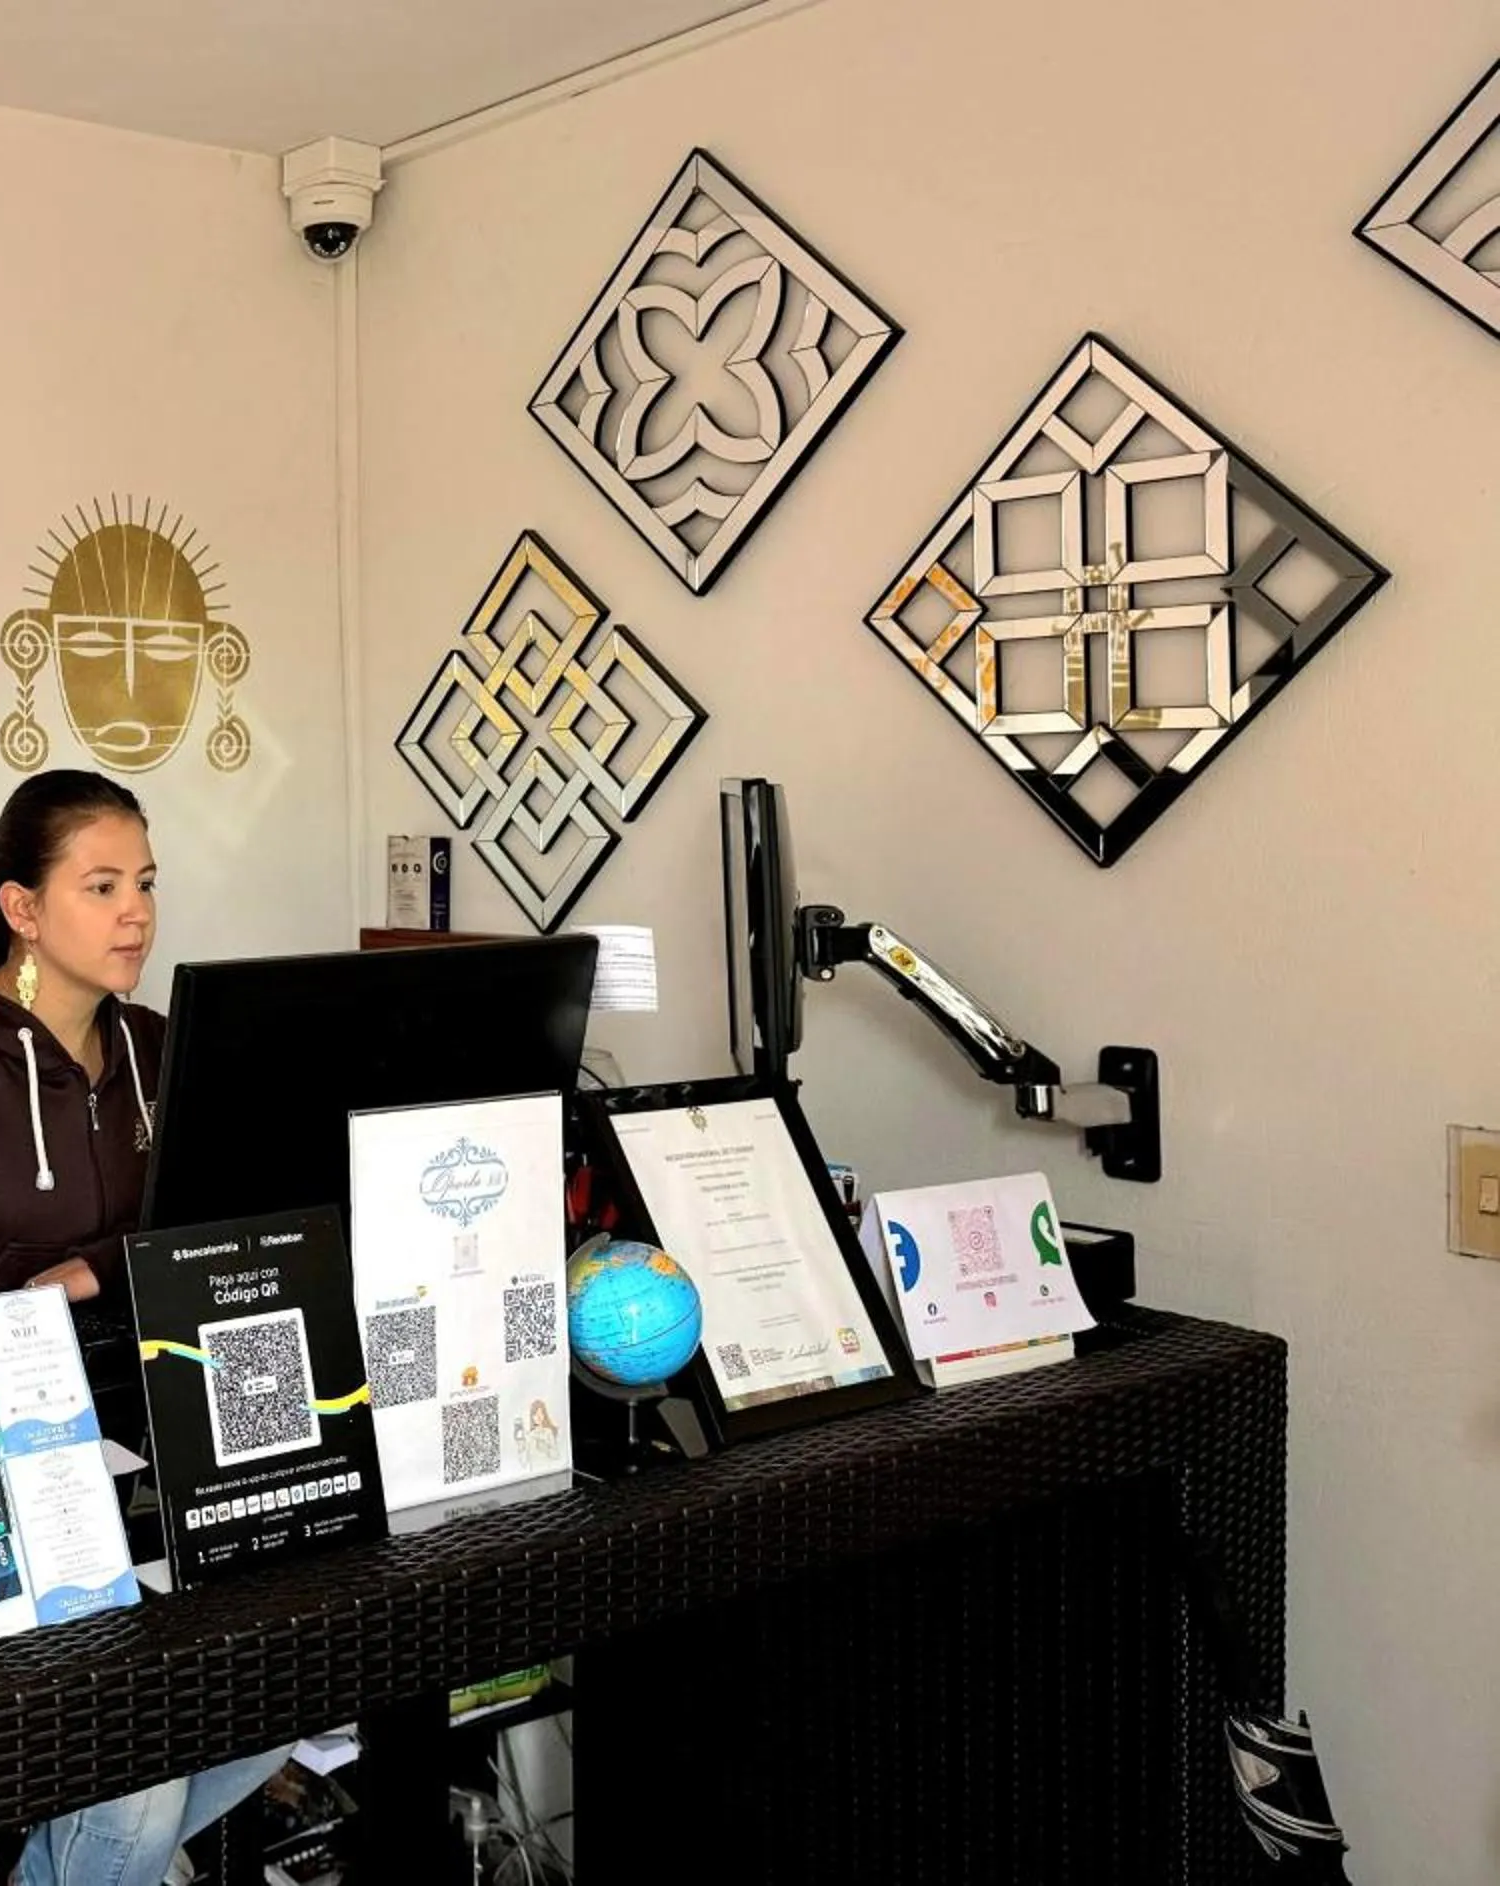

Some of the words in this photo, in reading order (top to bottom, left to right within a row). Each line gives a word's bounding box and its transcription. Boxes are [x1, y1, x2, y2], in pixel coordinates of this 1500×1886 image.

[208, 1274, 235, 1289] Paga
[260, 1267, 279, 1279] con
[214, 1285, 259, 1304] Código
[261, 1281, 280, 1297] QR
[304, 1525, 311, 1537] 3
[252, 1538, 259, 1550] 2
[198, 1551, 206, 1564] 1
